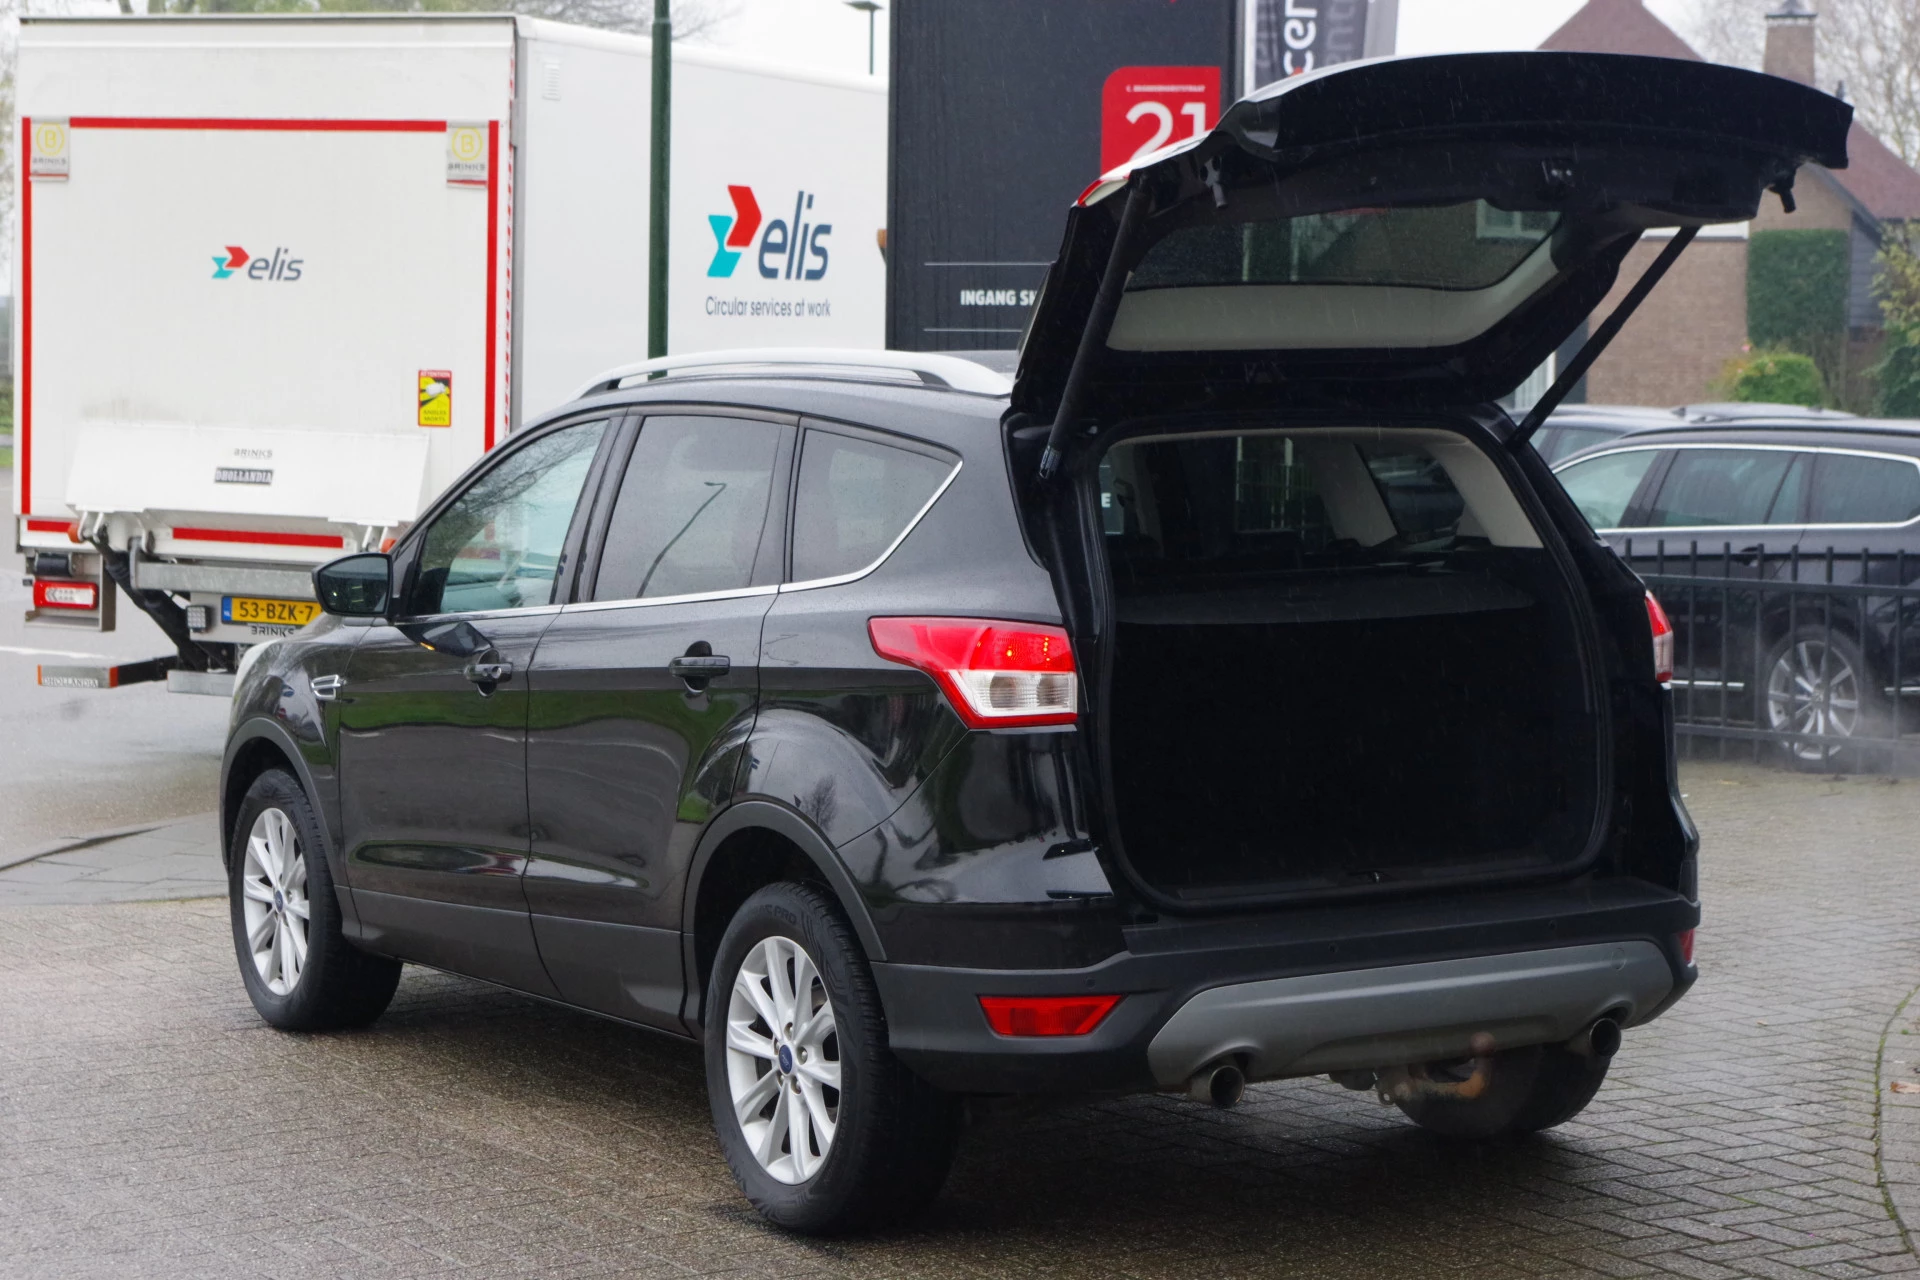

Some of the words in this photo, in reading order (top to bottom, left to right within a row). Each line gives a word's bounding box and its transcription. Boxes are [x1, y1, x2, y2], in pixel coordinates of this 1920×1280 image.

[1126, 101, 1205, 162] 21
[758, 191, 832, 281] elis
[248, 247, 304, 280] elis
[705, 296, 748, 316] Circular
[750, 299, 791, 316] services
[794, 298, 804, 316] at
[807, 299, 831, 316] work
[961, 290, 1016, 306] INGANG
[239, 601, 313, 622] 53-BZK-7
